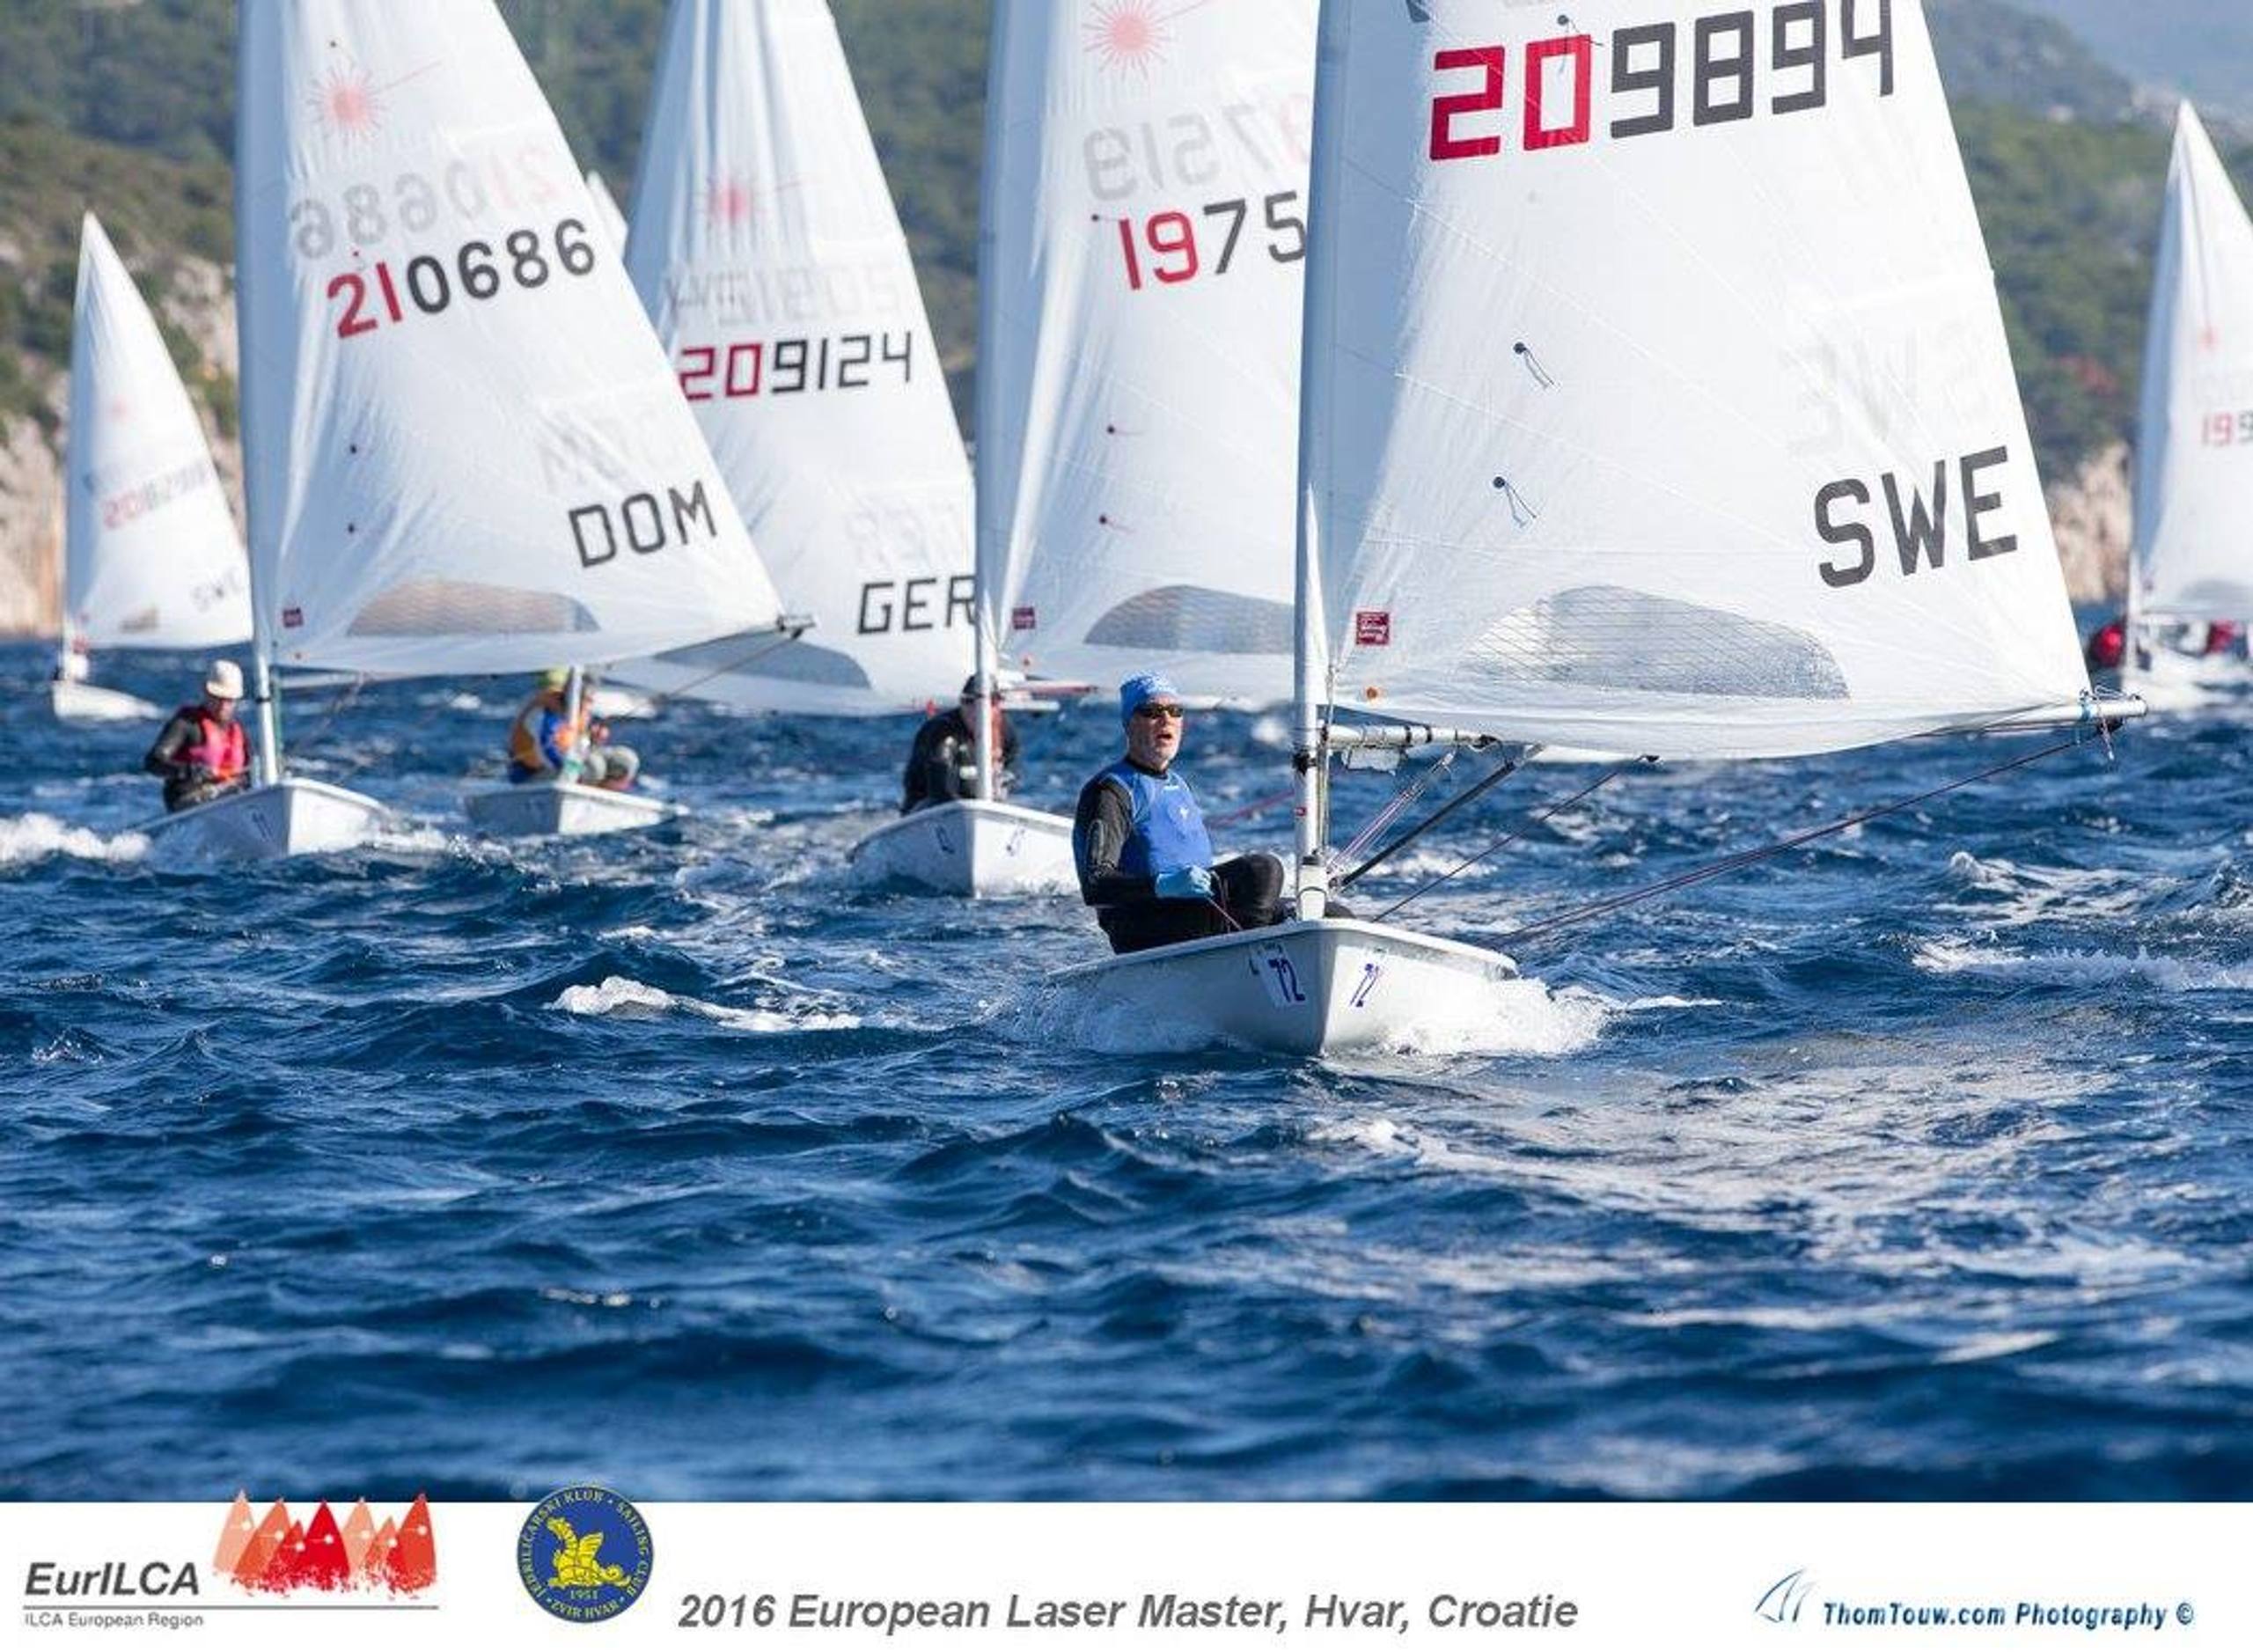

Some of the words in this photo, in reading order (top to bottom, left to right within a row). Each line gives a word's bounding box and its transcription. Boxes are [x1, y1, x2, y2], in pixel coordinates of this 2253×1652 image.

[1429, 0, 1894, 161] 209894
[327, 218, 594, 338] 210686
[1119, 190, 1306, 290] 1975
[679, 330, 911, 401] 209124
[569, 481, 718, 568] DOM
[1815, 445, 2018, 588] SWE
[857, 574, 976, 635] GER
